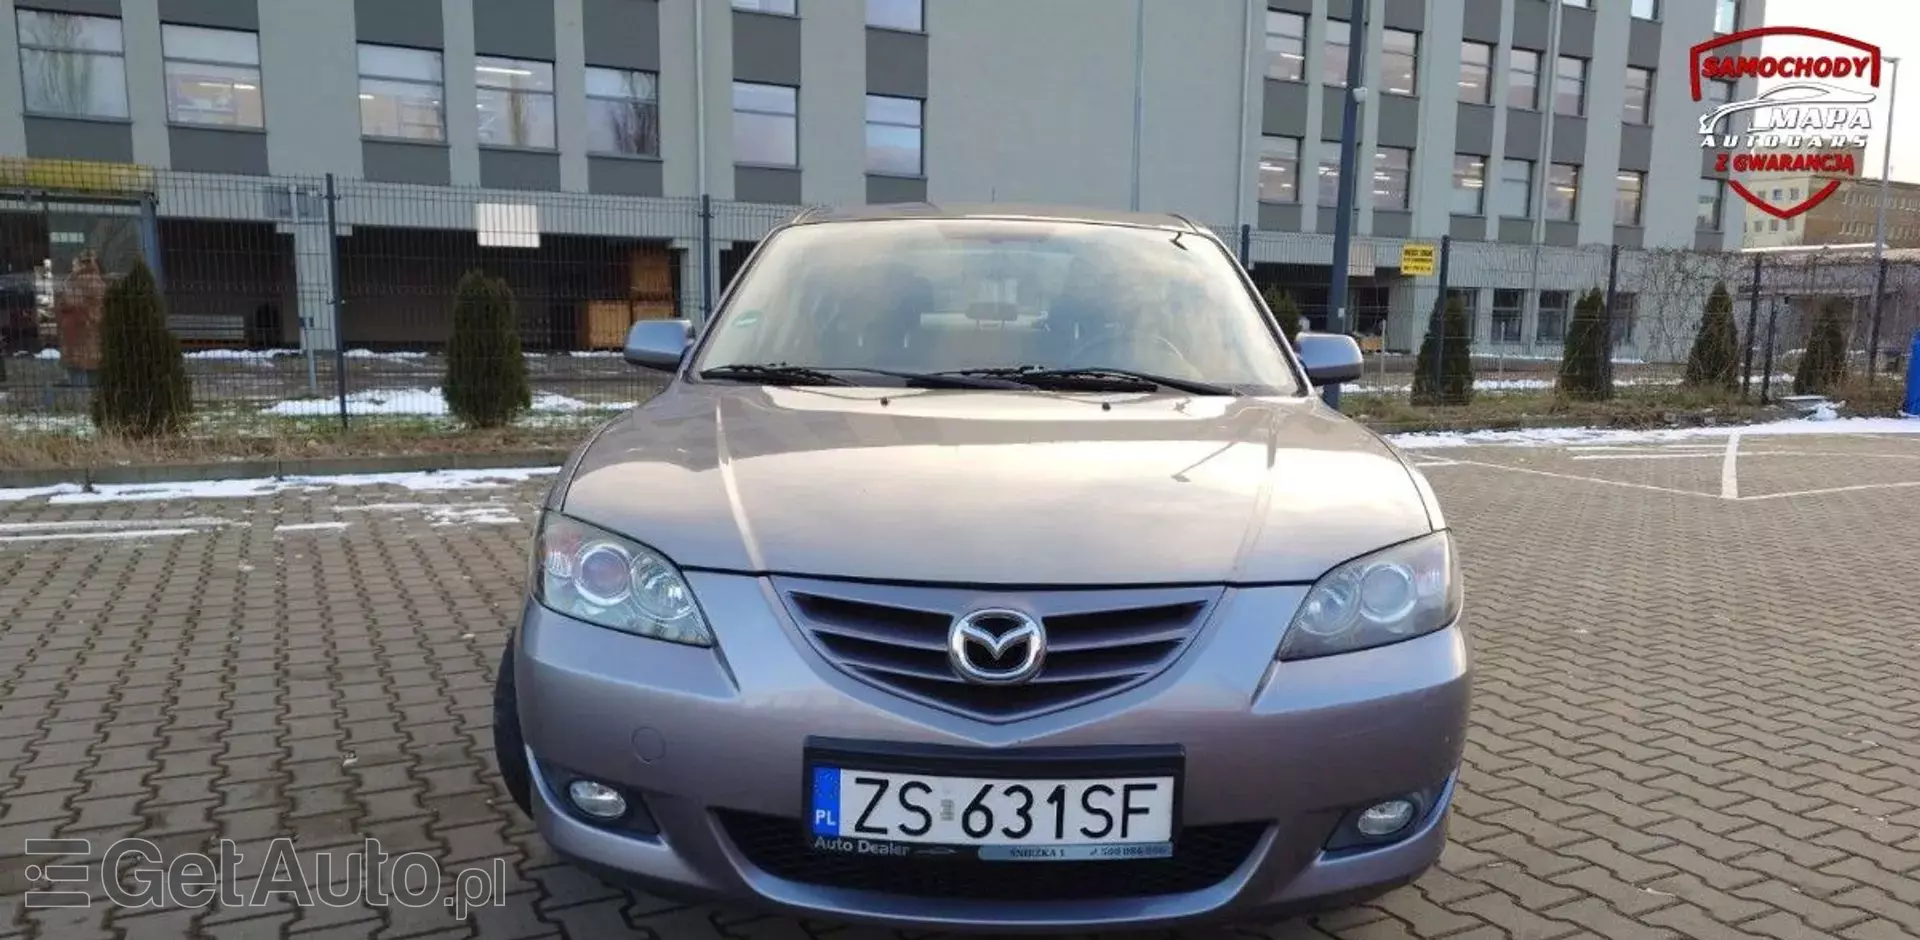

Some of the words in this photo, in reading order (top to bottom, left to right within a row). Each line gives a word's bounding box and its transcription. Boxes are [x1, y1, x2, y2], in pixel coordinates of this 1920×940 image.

[814, 809, 837, 826] PL
[854, 776, 933, 837] ZS
[961, 783, 1158, 839] 631SF
[814, 836, 854, 852] Auto
[857, 839, 910, 857] Dealer
